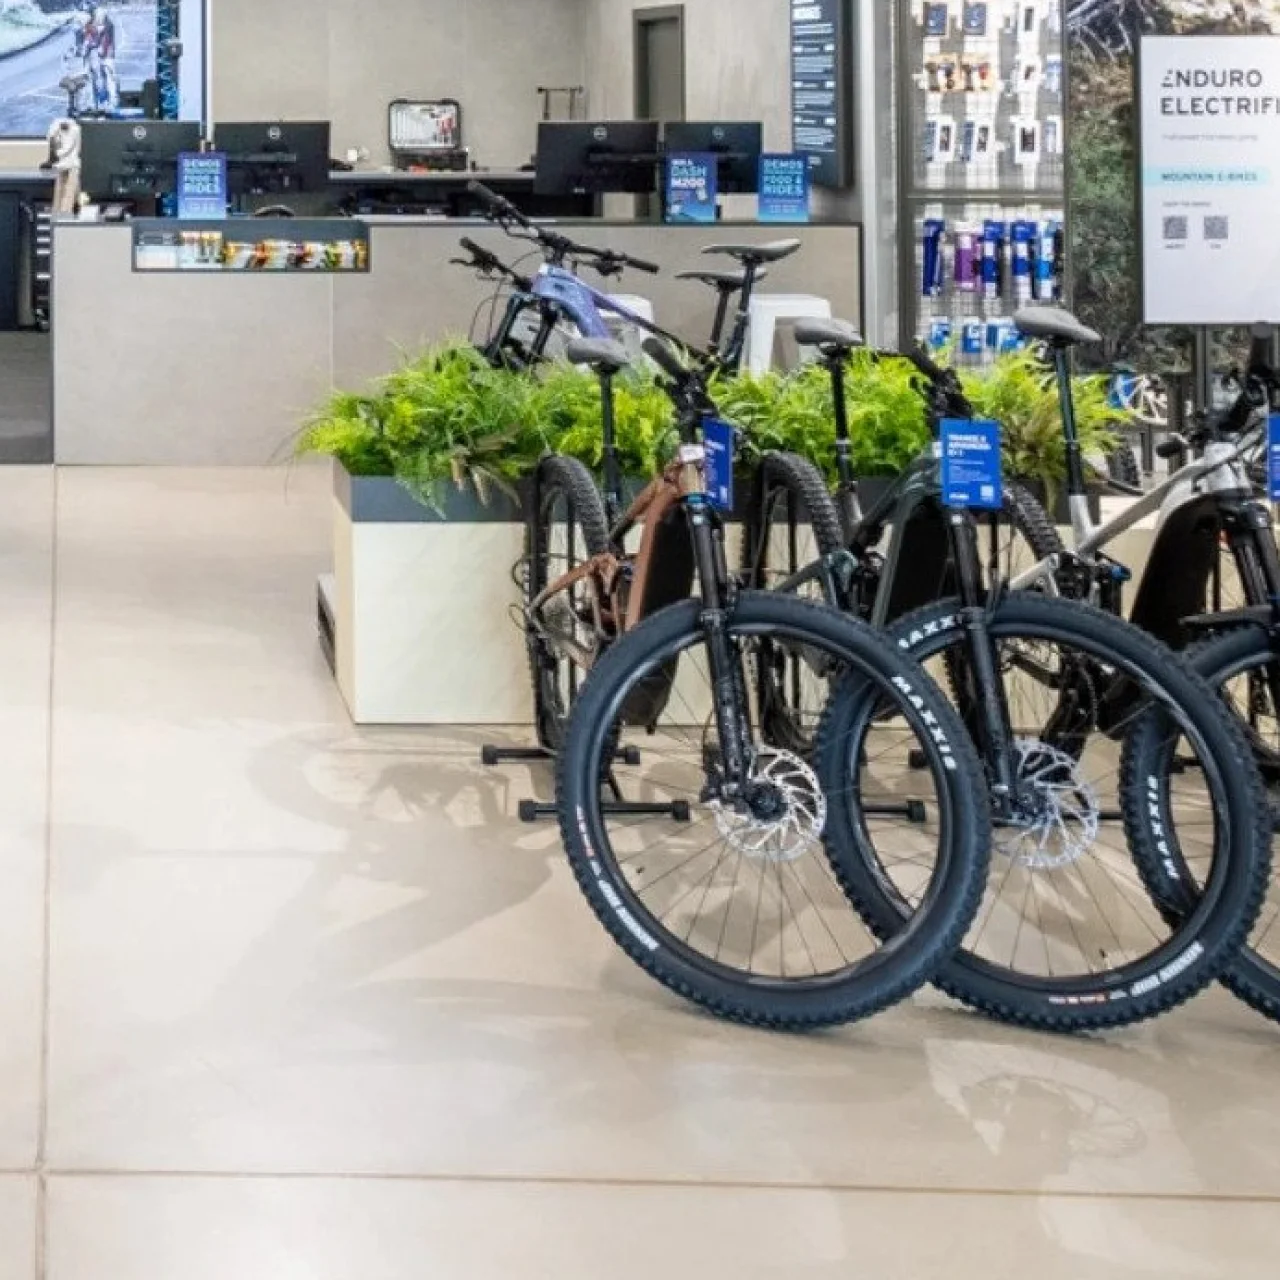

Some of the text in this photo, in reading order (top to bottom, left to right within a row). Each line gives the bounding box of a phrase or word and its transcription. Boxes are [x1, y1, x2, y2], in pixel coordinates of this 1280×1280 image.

[1161, 68, 1263, 88] ENDURO
[891, 675, 957, 770] MAXXIS
[1147, 774, 1181, 880] MAXXIS
